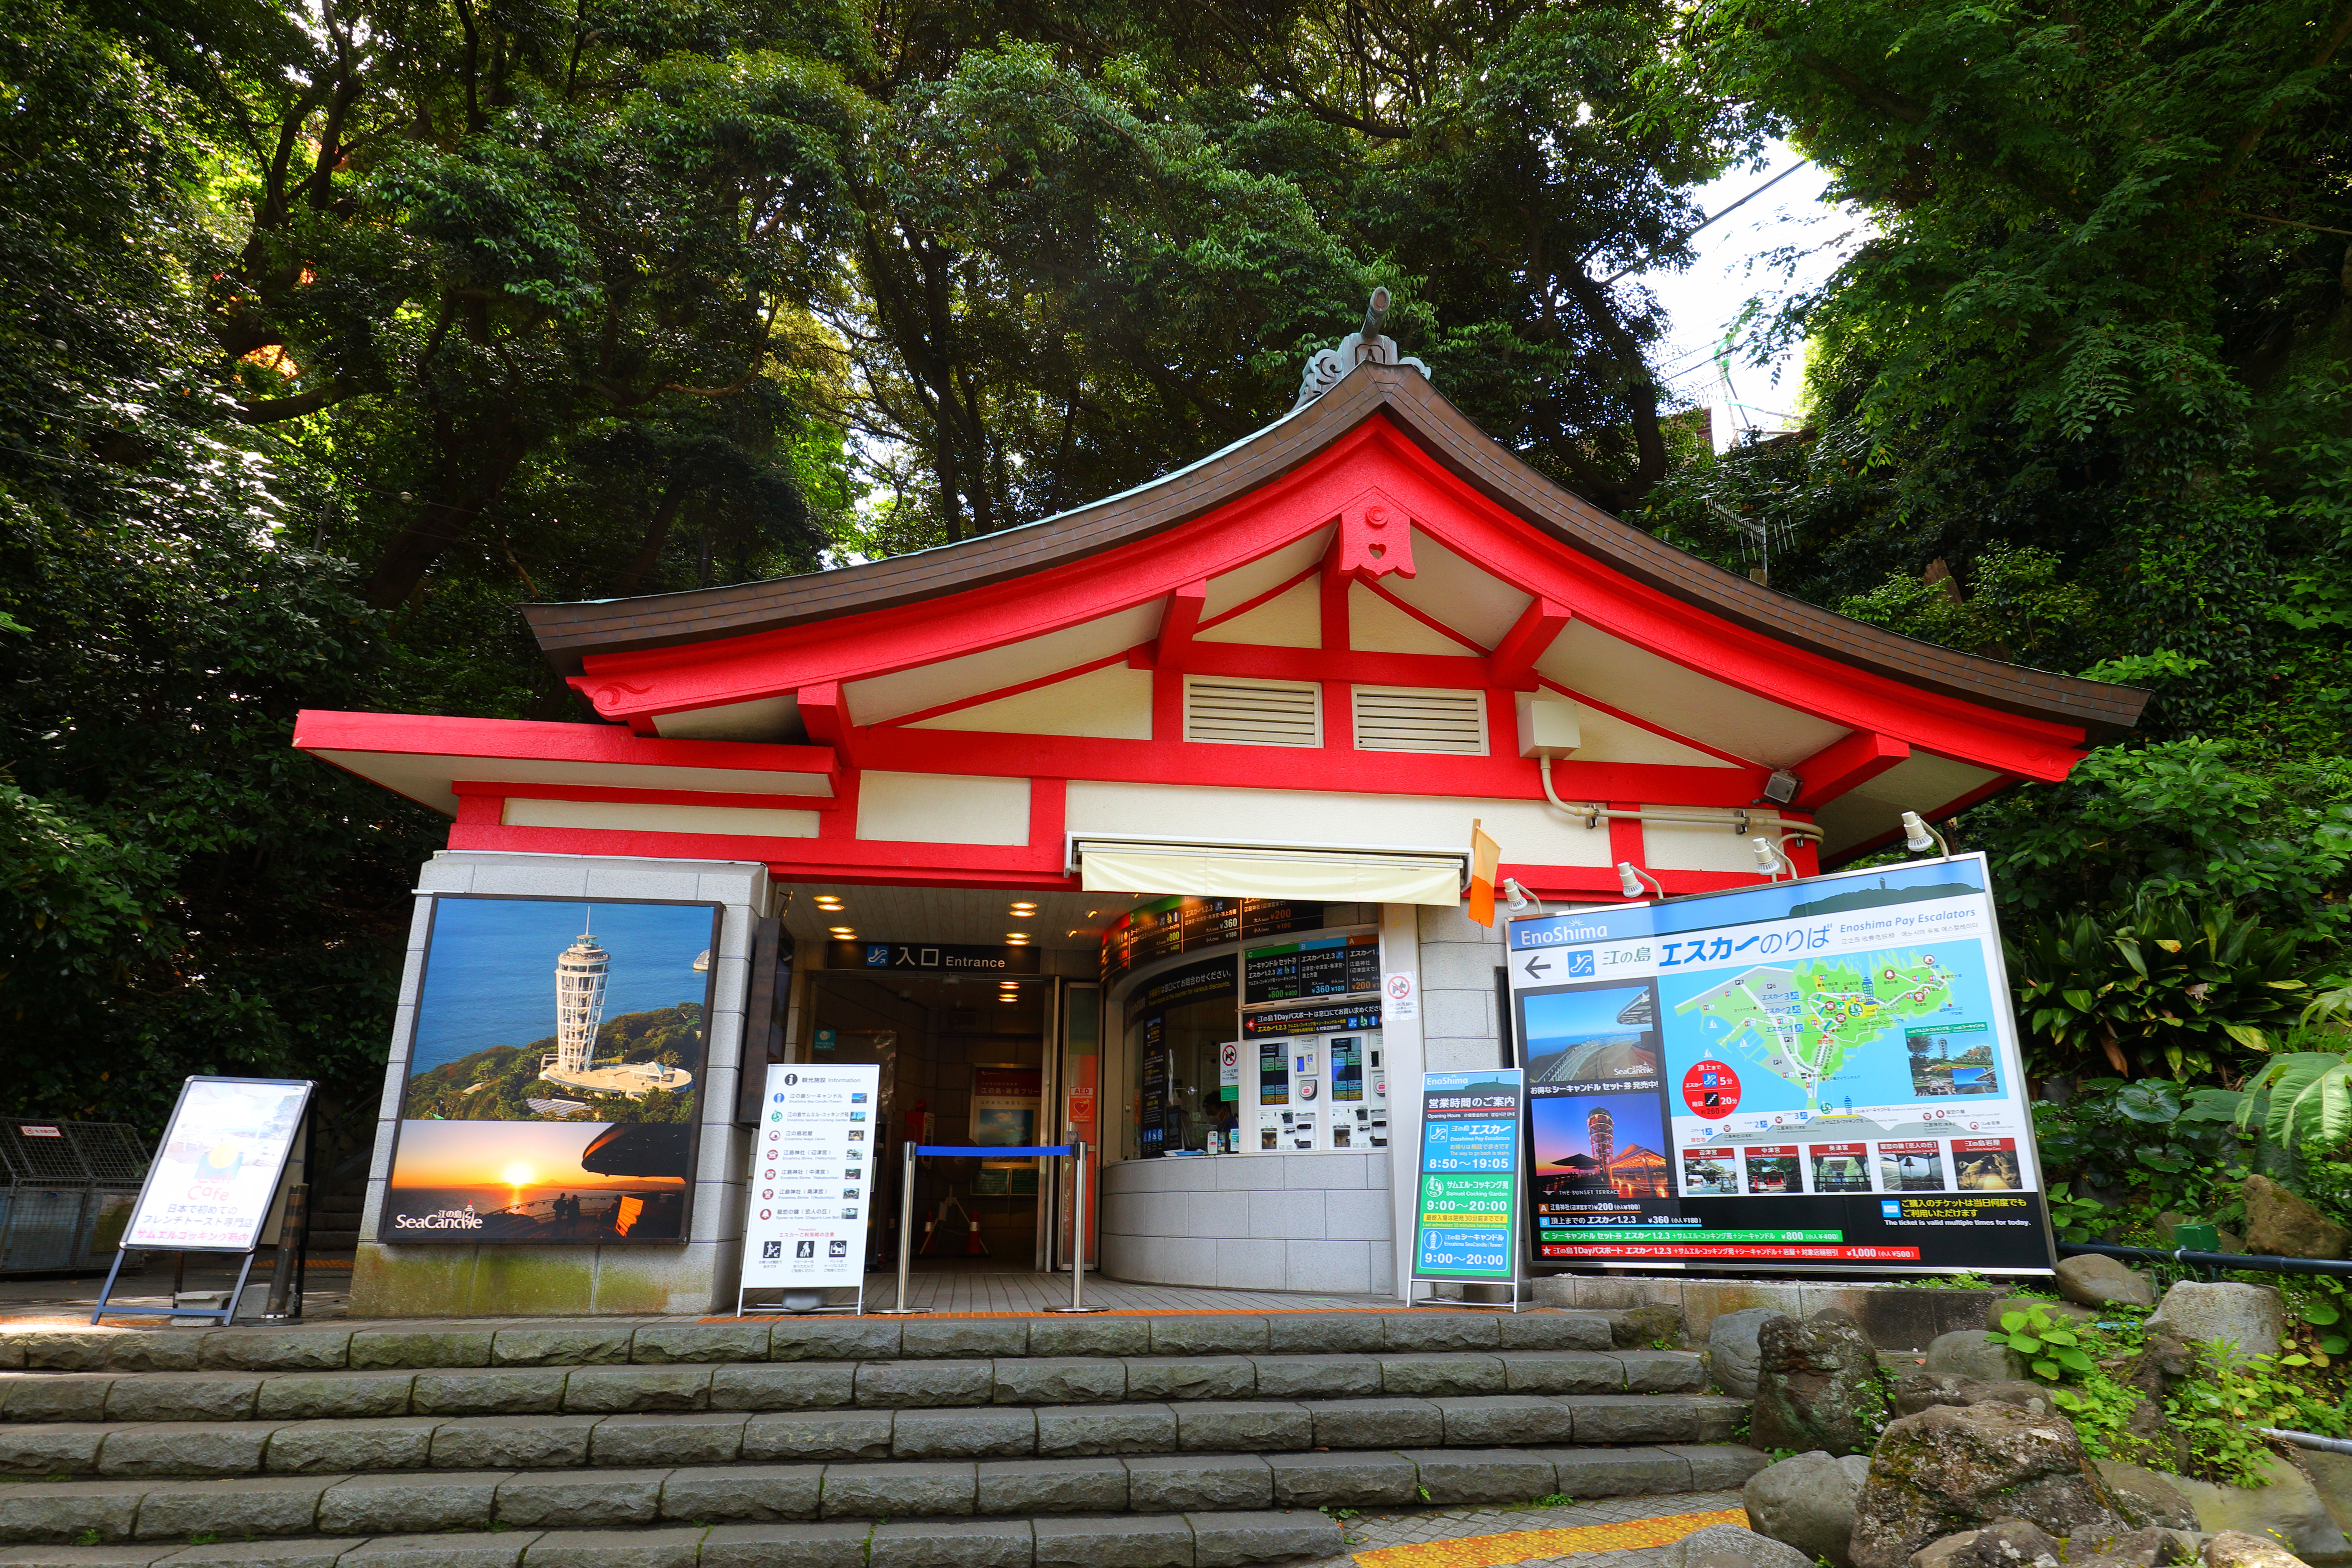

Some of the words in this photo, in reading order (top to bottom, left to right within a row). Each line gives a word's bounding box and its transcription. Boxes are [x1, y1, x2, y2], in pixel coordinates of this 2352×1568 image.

[1130, 913, 1134, 923] C
[1270, 909, 1291, 920] ¥200
[1220, 917, 1238, 929] ¥360
[1840, 920, 1893, 933] Enoshima
[1895, 916, 1915, 927] Pay
[1918, 908, 1976, 923] Escalators
[1166, 931, 1180, 943] ¥800
[1521, 925, 1607, 945] EnoShima
[895, 947, 939, 966] 入口
[946, 956, 1005, 968] Entrance
[1301, 953, 1335, 962] エスカー1.2.3
[1603, 946, 1652, 965] 江の島
[1248, 970, 1276, 978] エスカー1.2.3
[1311, 985, 1329, 993] ¥360
[1352, 981, 1370, 990] ¥200
[1268, 990, 1287, 998] ¥800
[1427, 1077, 1468, 1085] EnoShima
[1632, 1080, 1659, 1089] 発売中!
[1719, 1077, 1733, 1085] 5分
[1429, 1096, 1515, 1109] 営業時間のご案内
[198, 1169, 232, 1184] Lon
[1447, 1181, 1509, 1189] サムエル・コッキング苑
[188, 1185, 229, 1201] Cafe
[1902, 1199, 2027, 1208] ご購入のチケットは当日何度でも
[167, 1204, 237, 1214] 日本で初めての
[1903, 1209, 1978, 1218] ご利用いただけます
[438, 1210, 461, 1219] 江の島
[1587, 1215, 1636, 1224] エスカー1.2.3
[1648, 1215, 1669, 1224] ¥360
[143, 1214, 254, 1228] フレンチトースト専門店
[395, 1212, 483, 1229] SeaCandle
[138, 1229, 249, 1243] サムエルコッキング苑内
[1781, 1231, 1804, 1240] ¥800
[1846, 1248, 1876, 1258] ¥1,000
